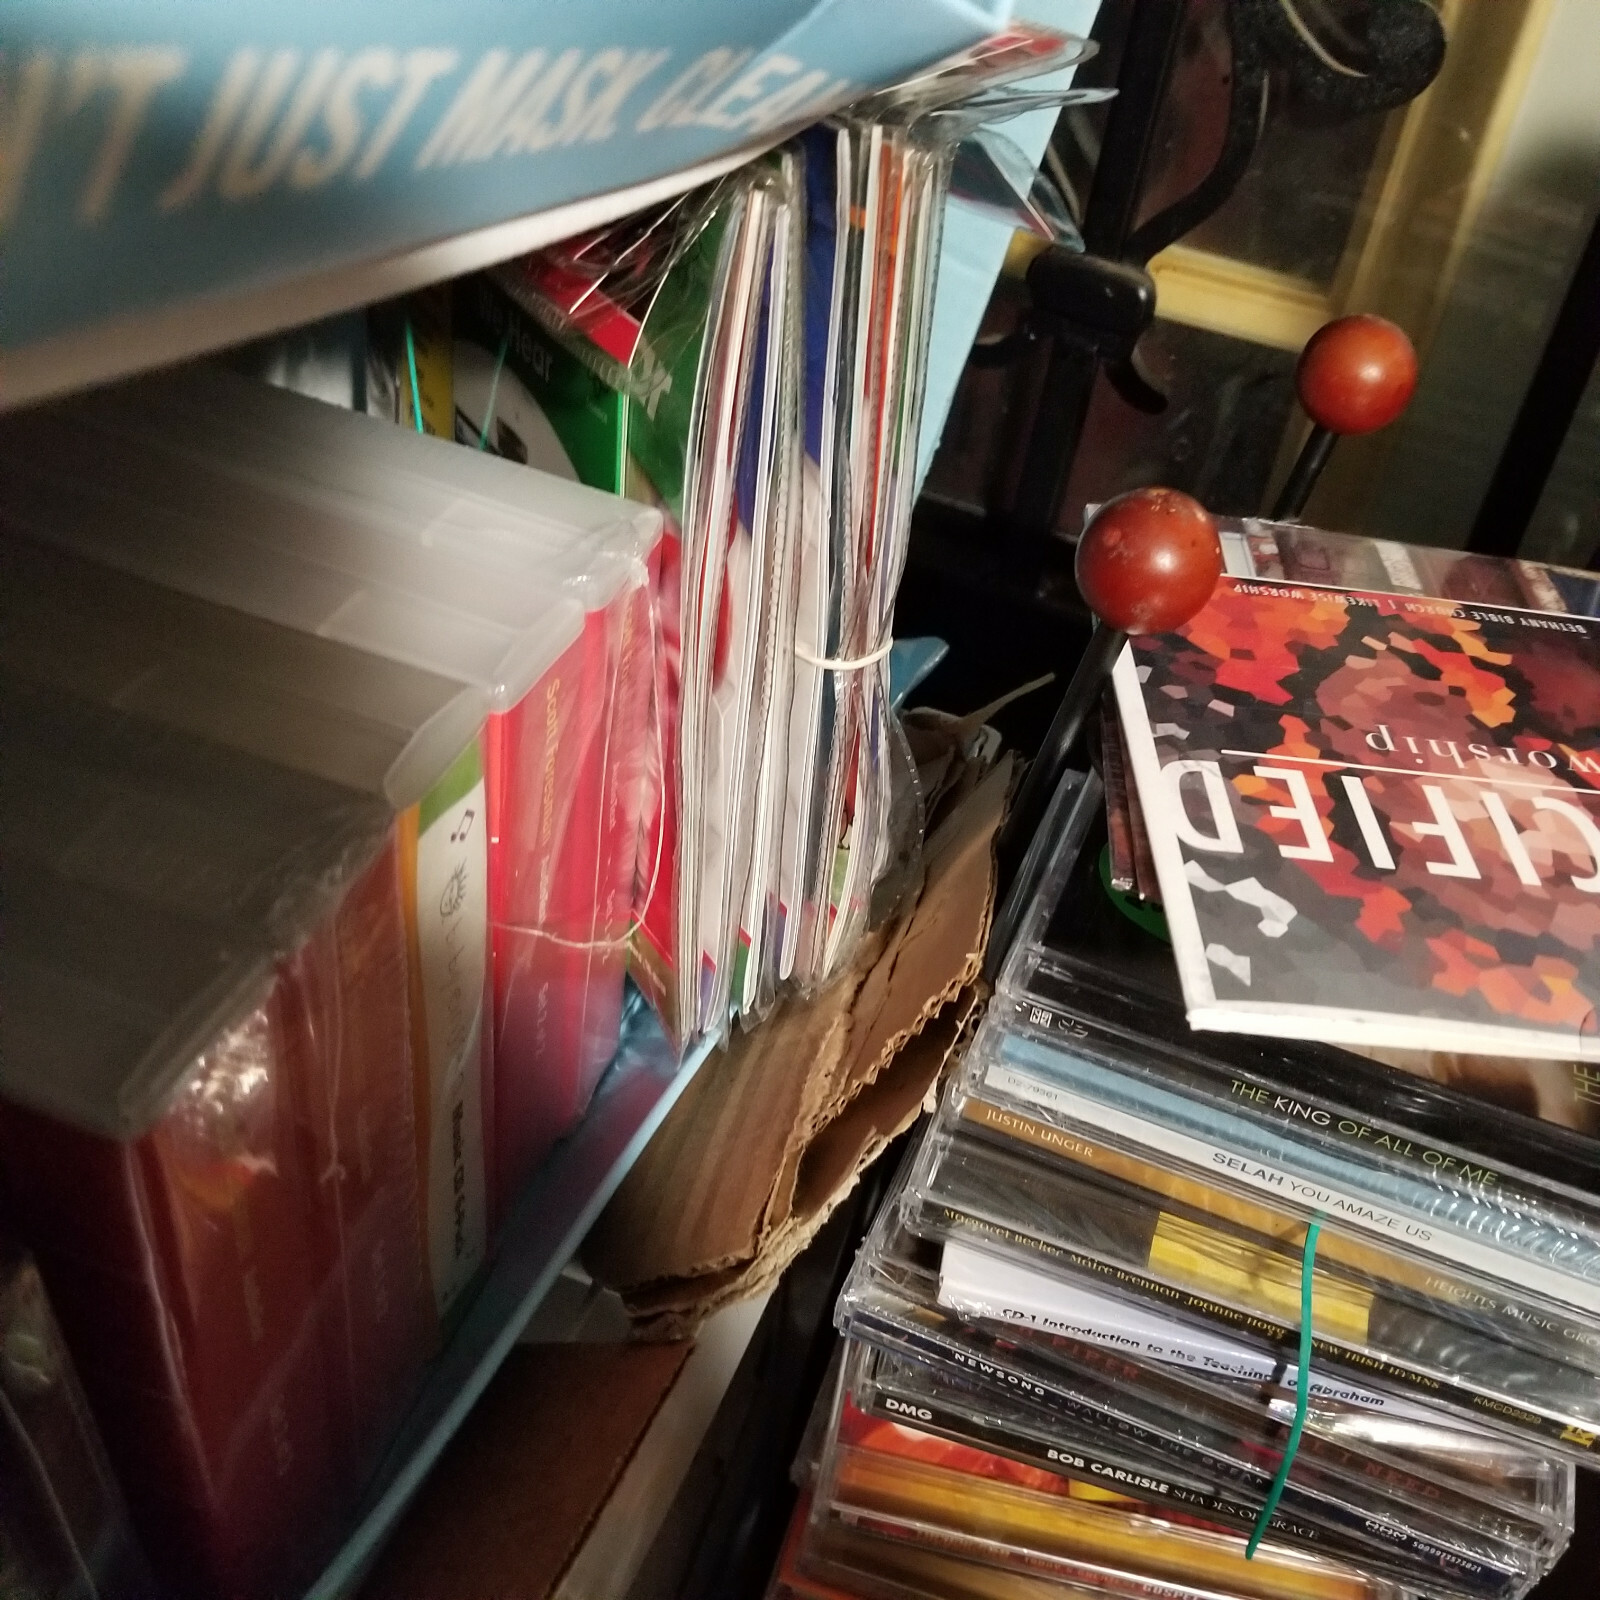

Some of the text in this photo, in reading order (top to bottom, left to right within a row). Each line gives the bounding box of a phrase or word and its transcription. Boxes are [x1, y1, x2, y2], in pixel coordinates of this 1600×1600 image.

[157, 44, 458, 214] JUST
[413, 46, 670, 172] MASK
[1232, 583, 1588, 635] BETHANY BIBLE CHURCH LIKEWISE WORSHIP
[546, 678, 560, 742] Scott
[1365, 723, 1600, 775] worship
[542, 743, 558, 846] Foresman
[985, 1108, 1094, 1158] JUSTIN UNGER
[1230, 1079, 1498, 1186] THE KING OF ALL OF ME
[1212, 1152, 1434, 1242] SELAH YOU AMAZE US
[943, 1207, 1011, 1240] Margaret
[1014, 1233, 1064, 1258] Becker
[1116, 1269, 1181, 1300] Brennan
[1183, 1294, 1244, 1325] Joanne
[1246, 1316, 1288, 1340] Hogg
[1424, 1276, 1498, 1310] HEIGHTS
[1501, 1304, 1560, 1333] MUSIC
[1002, 1308, 1038, 1324] CD-1
[1041, 1316, 1142, 1350] Introduction
[1146, 1343, 1164, 1355] to
[1168, 1347, 1198, 1364] the
[1309, 1383, 1386, 1407] Abraham
[1310, 1338, 1441, 1390] NEW IRISH HYMNS
[885, 1398, 933, 1421] DMG
[953, 1351, 1046, 1396] NEWSONG
[1060, 1397, 1148, 1438] WALLOW
[1158, 1437, 1192, 1457] THE
[1046, 1448, 1086, 1469] BOB
[1089, 1462, 1171, 1495] CARLISLE
[1172, 1488, 1237, 1515] SHADES
